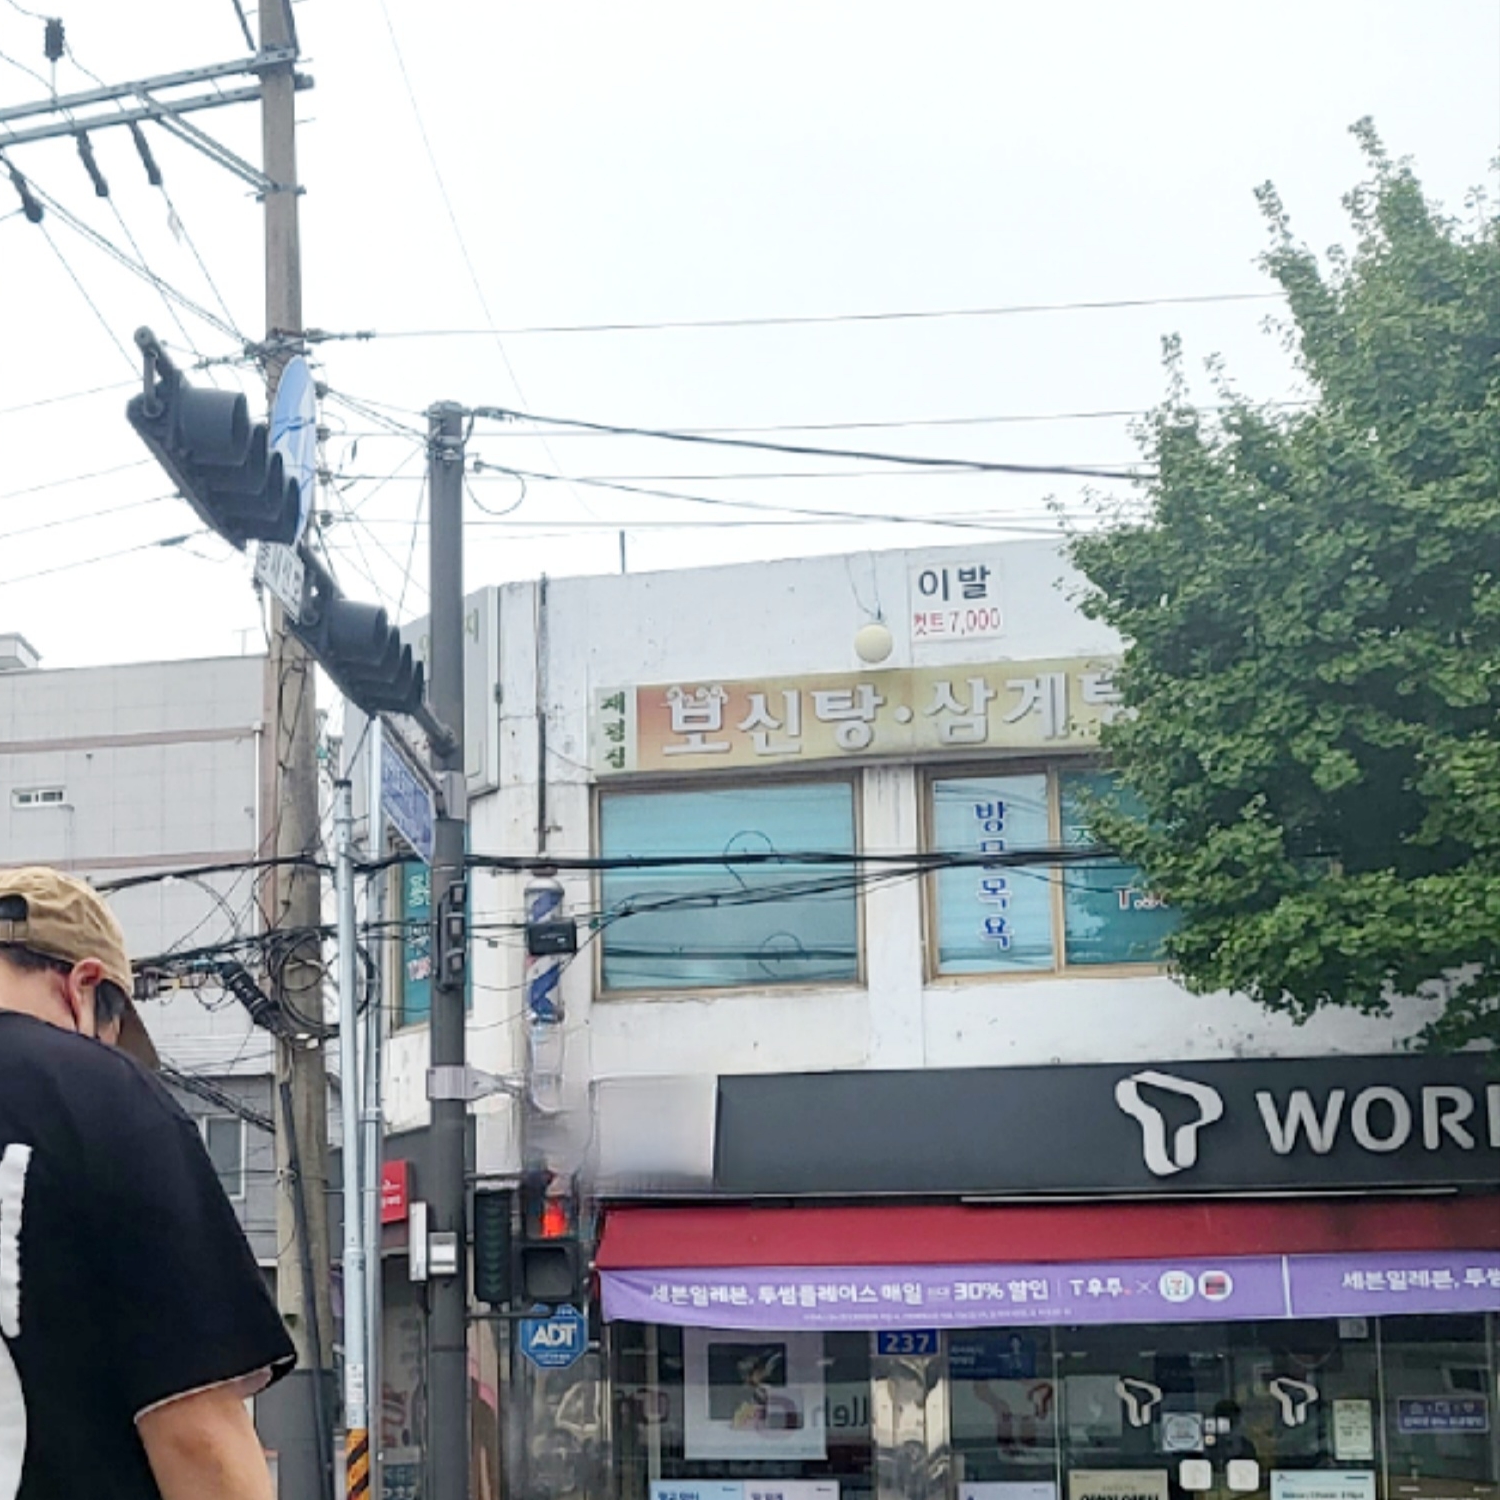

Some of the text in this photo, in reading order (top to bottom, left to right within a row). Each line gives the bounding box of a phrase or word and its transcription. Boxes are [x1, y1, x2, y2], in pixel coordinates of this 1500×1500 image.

[918, 564, 992, 601] 이발
[949, 607, 1001, 635] 7,000
[954, 1281, 1005, 1301] 30%
[530, 1322, 578, 1347] ADT
[885, 1333, 931, 1353] 237
